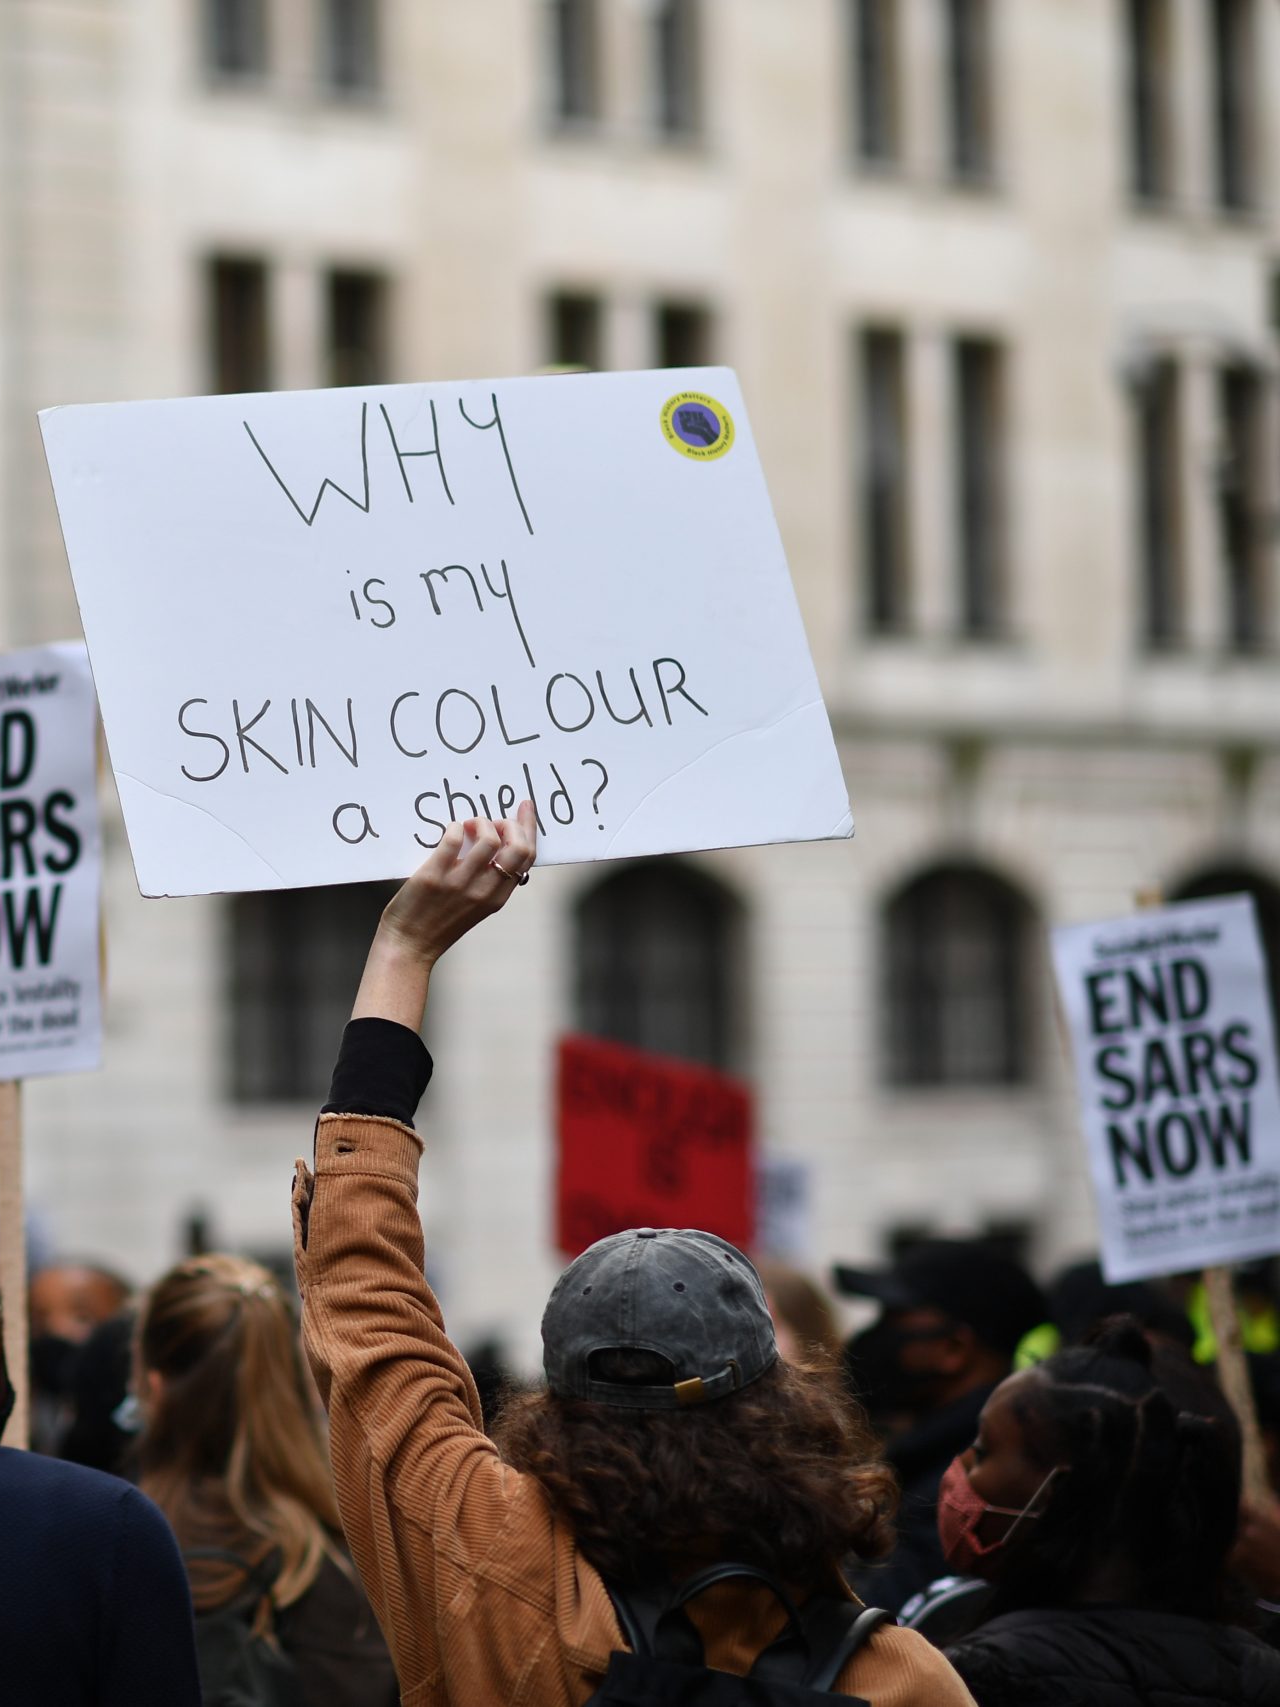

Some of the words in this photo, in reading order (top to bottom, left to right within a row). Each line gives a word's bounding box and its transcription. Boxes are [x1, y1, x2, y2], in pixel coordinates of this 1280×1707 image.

[243, 393, 534, 535] WHY
[345, 569, 396, 629] is
[419, 558, 536, 668] my
[176, 697, 359, 782] SKIN
[388, 656, 709, 758] COLOUR
[331, 801, 380, 844] a
[413, 757, 609, 849] shield?
[1083, 957, 1211, 1036] END
[1095, 1022, 1260, 1112] SARS
[1105, 1100, 1252, 1188] NOW
